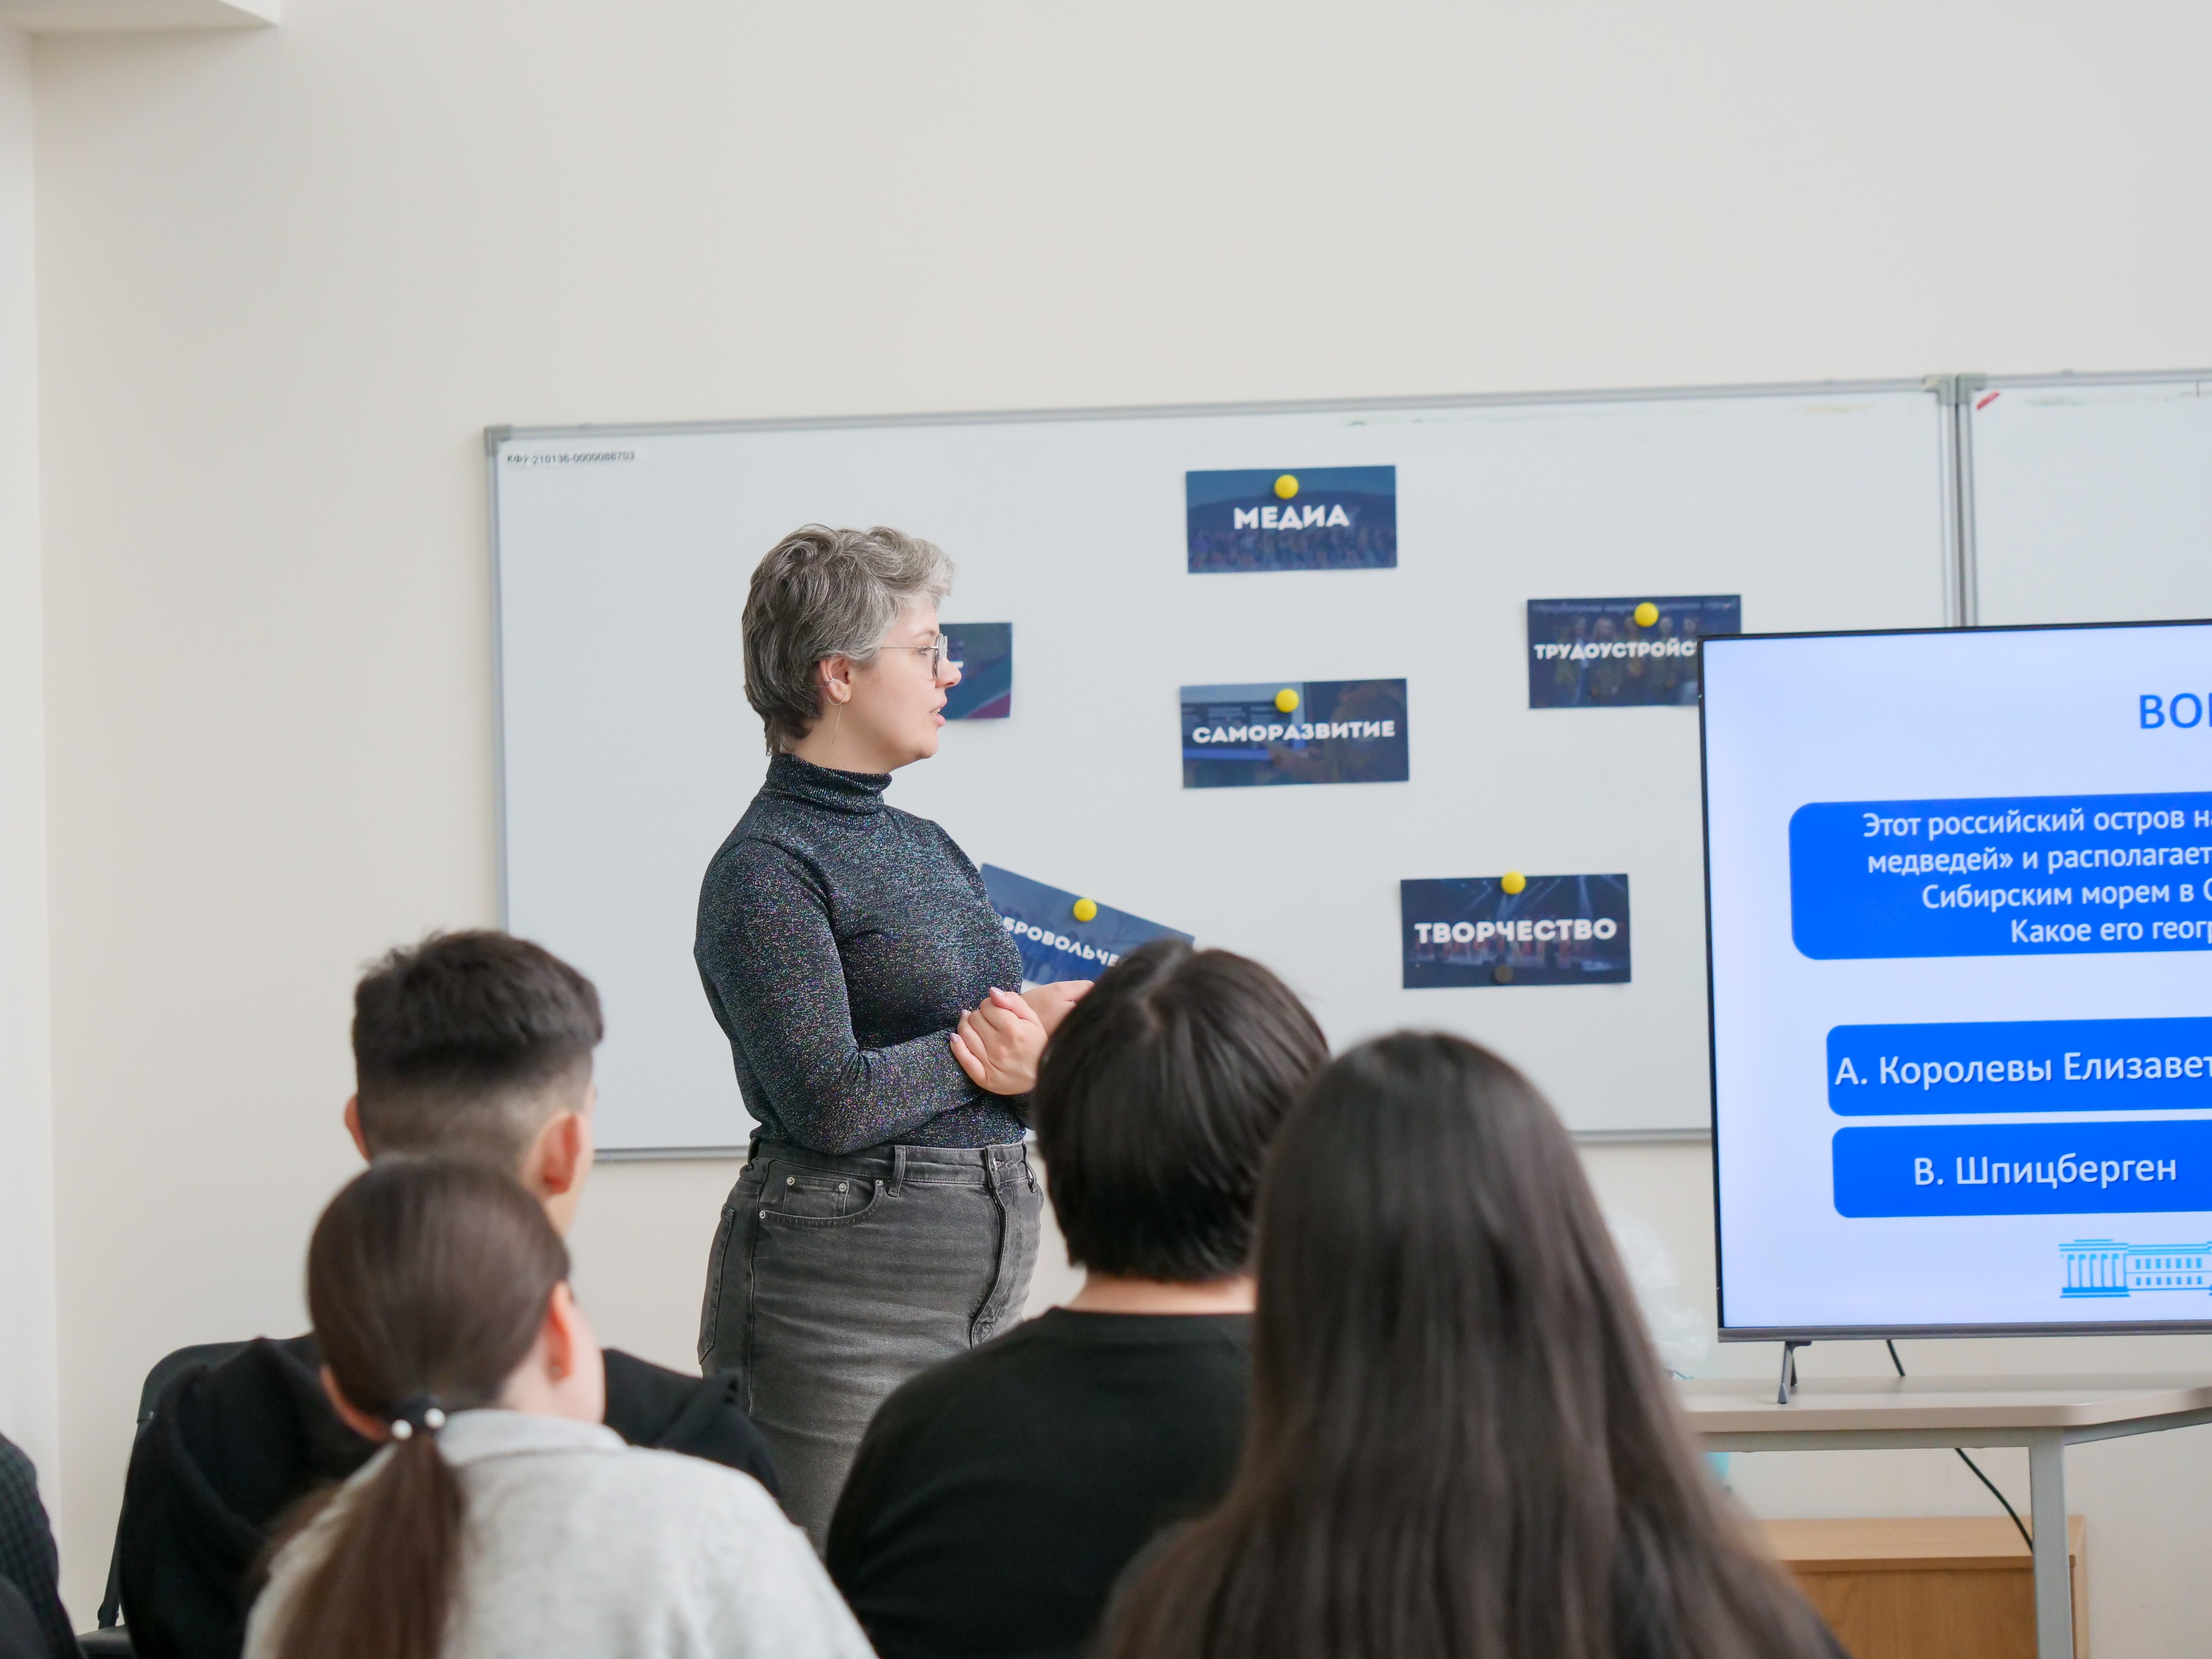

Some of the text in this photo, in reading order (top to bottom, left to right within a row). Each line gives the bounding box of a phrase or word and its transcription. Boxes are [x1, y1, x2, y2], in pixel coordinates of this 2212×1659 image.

[1234, 504, 1350, 530] МЕДИА
[1534, 637, 1697, 661] ТРУДОУСТРОЙС
[2139, 693, 2212, 729] ВО
[1192, 720, 1396, 743] САМОРАЗВИТИЕ
[1863, 808, 2212, 841] Этот российский остров н
[1868, 846, 2212, 876] медведей» и располагает
[1922, 883, 2072, 912] Сибирским
[2082, 885, 2170, 909] морем
[2180, 884, 2194, 902] в
[1003, 916, 1120, 967] БРОВОЛЬЧЕ
[1414, 918, 1617, 944] ТВОРЧЕСТВО
[2011, 919, 2212, 944] Какое его геог
[1835, 1057, 1868, 1085] А.
[1880, 1056, 2052, 1091] Королевы
[1914, 1153, 2177, 1189] В. Шпицберген
